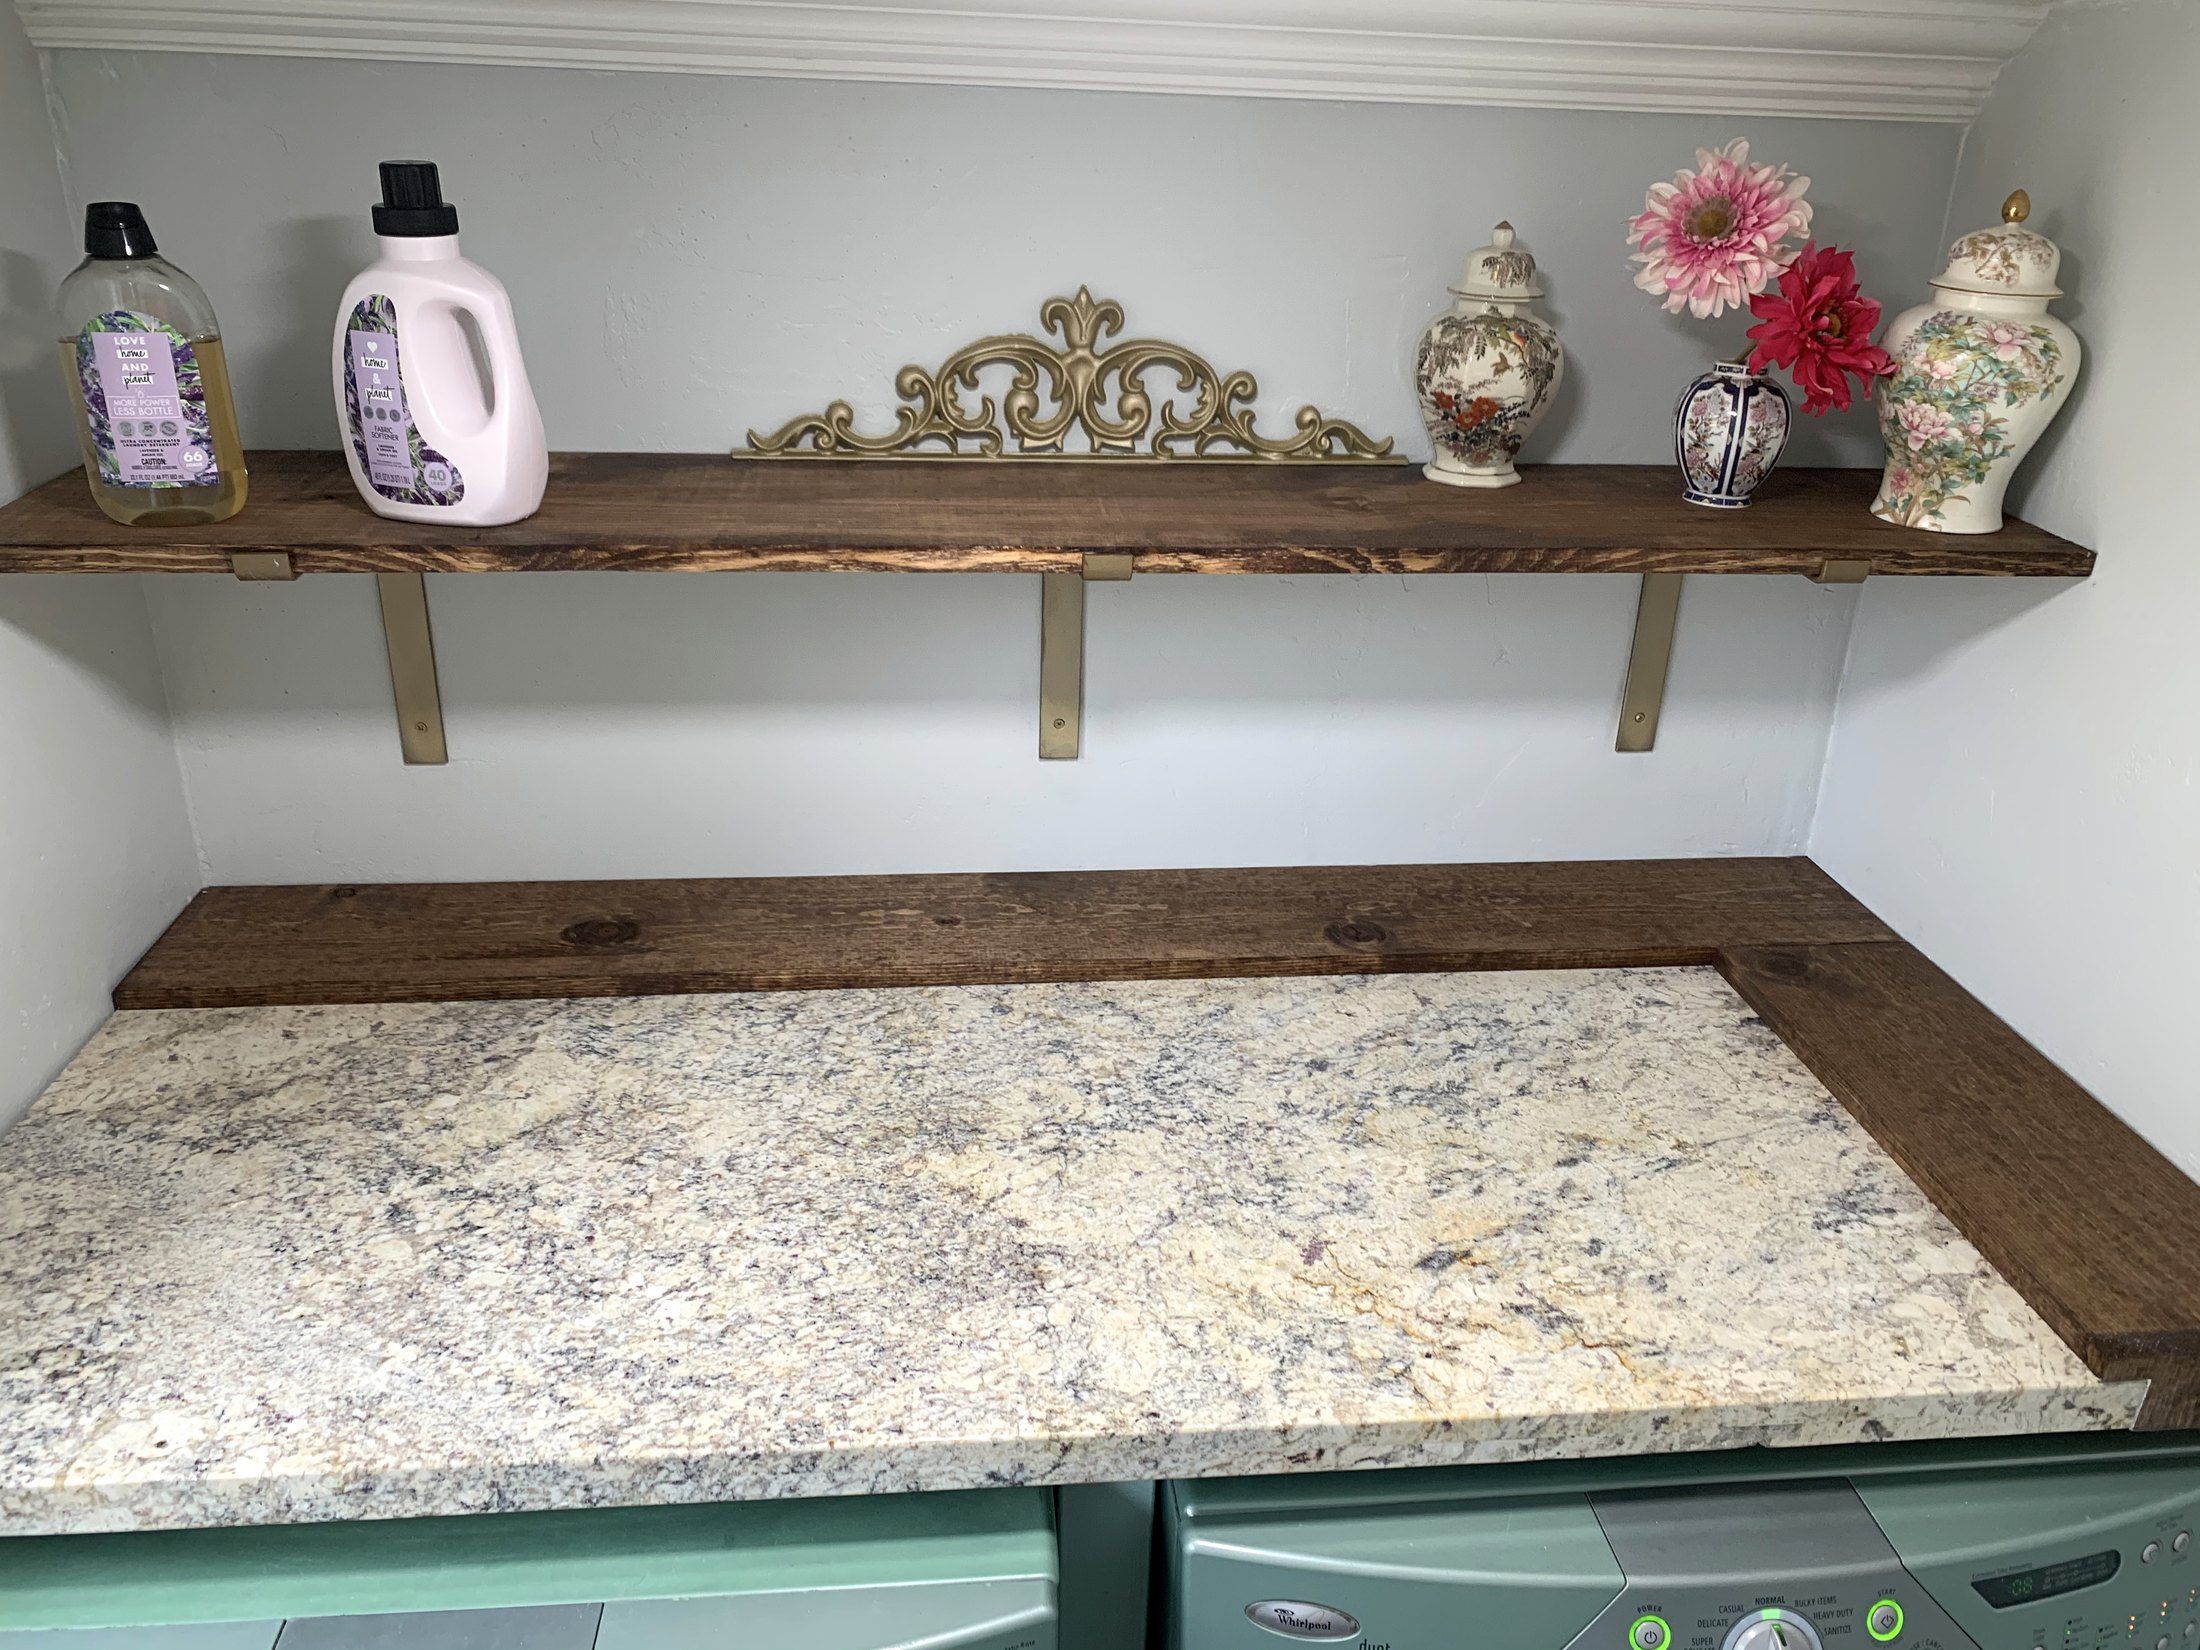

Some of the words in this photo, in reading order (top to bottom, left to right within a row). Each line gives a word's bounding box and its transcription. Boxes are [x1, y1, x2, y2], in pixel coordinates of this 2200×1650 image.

[114, 336, 146, 345] LOVE
[119, 346, 146, 358] home
[363, 352, 387, 368] home
[122, 363, 149, 371] AND
[123, 371, 156, 390] planet
[372, 373, 381, 385] &
[365, 385, 395, 404] planet
[113, 399, 137, 407] MORE
[113, 407, 136, 416] LESS
[138, 406, 174, 416] BOTTLE
[374, 425, 393, 434] FABRIC
[371, 431, 399, 441] SOFTENER
[183, 450, 204, 462] 66
[429, 469, 447, 482] 40
[1877, 1588, 1897, 1597] START
[1755, 1595, 1786, 1605] NORMAL
[1794, 1598, 1816, 1607] BULKY
[1817, 1595, 1837, 1606] ITEMS
[1637, 1604, 1662, 1614] POWER
[1718, 1604, 1745, 1614] CASUAL
[1813, 1610, 1835, 1620] HEAVY
[1836, 1608, 1854, 1618] DUTY
[1278, 1614, 1331, 1631] Whirlpool
[1697, 1618, 1729, 1629] DELICATE
[1823, 1624, 1852, 1636] SANITIZE
[1691, 1637, 1714, 1646] SUPER
